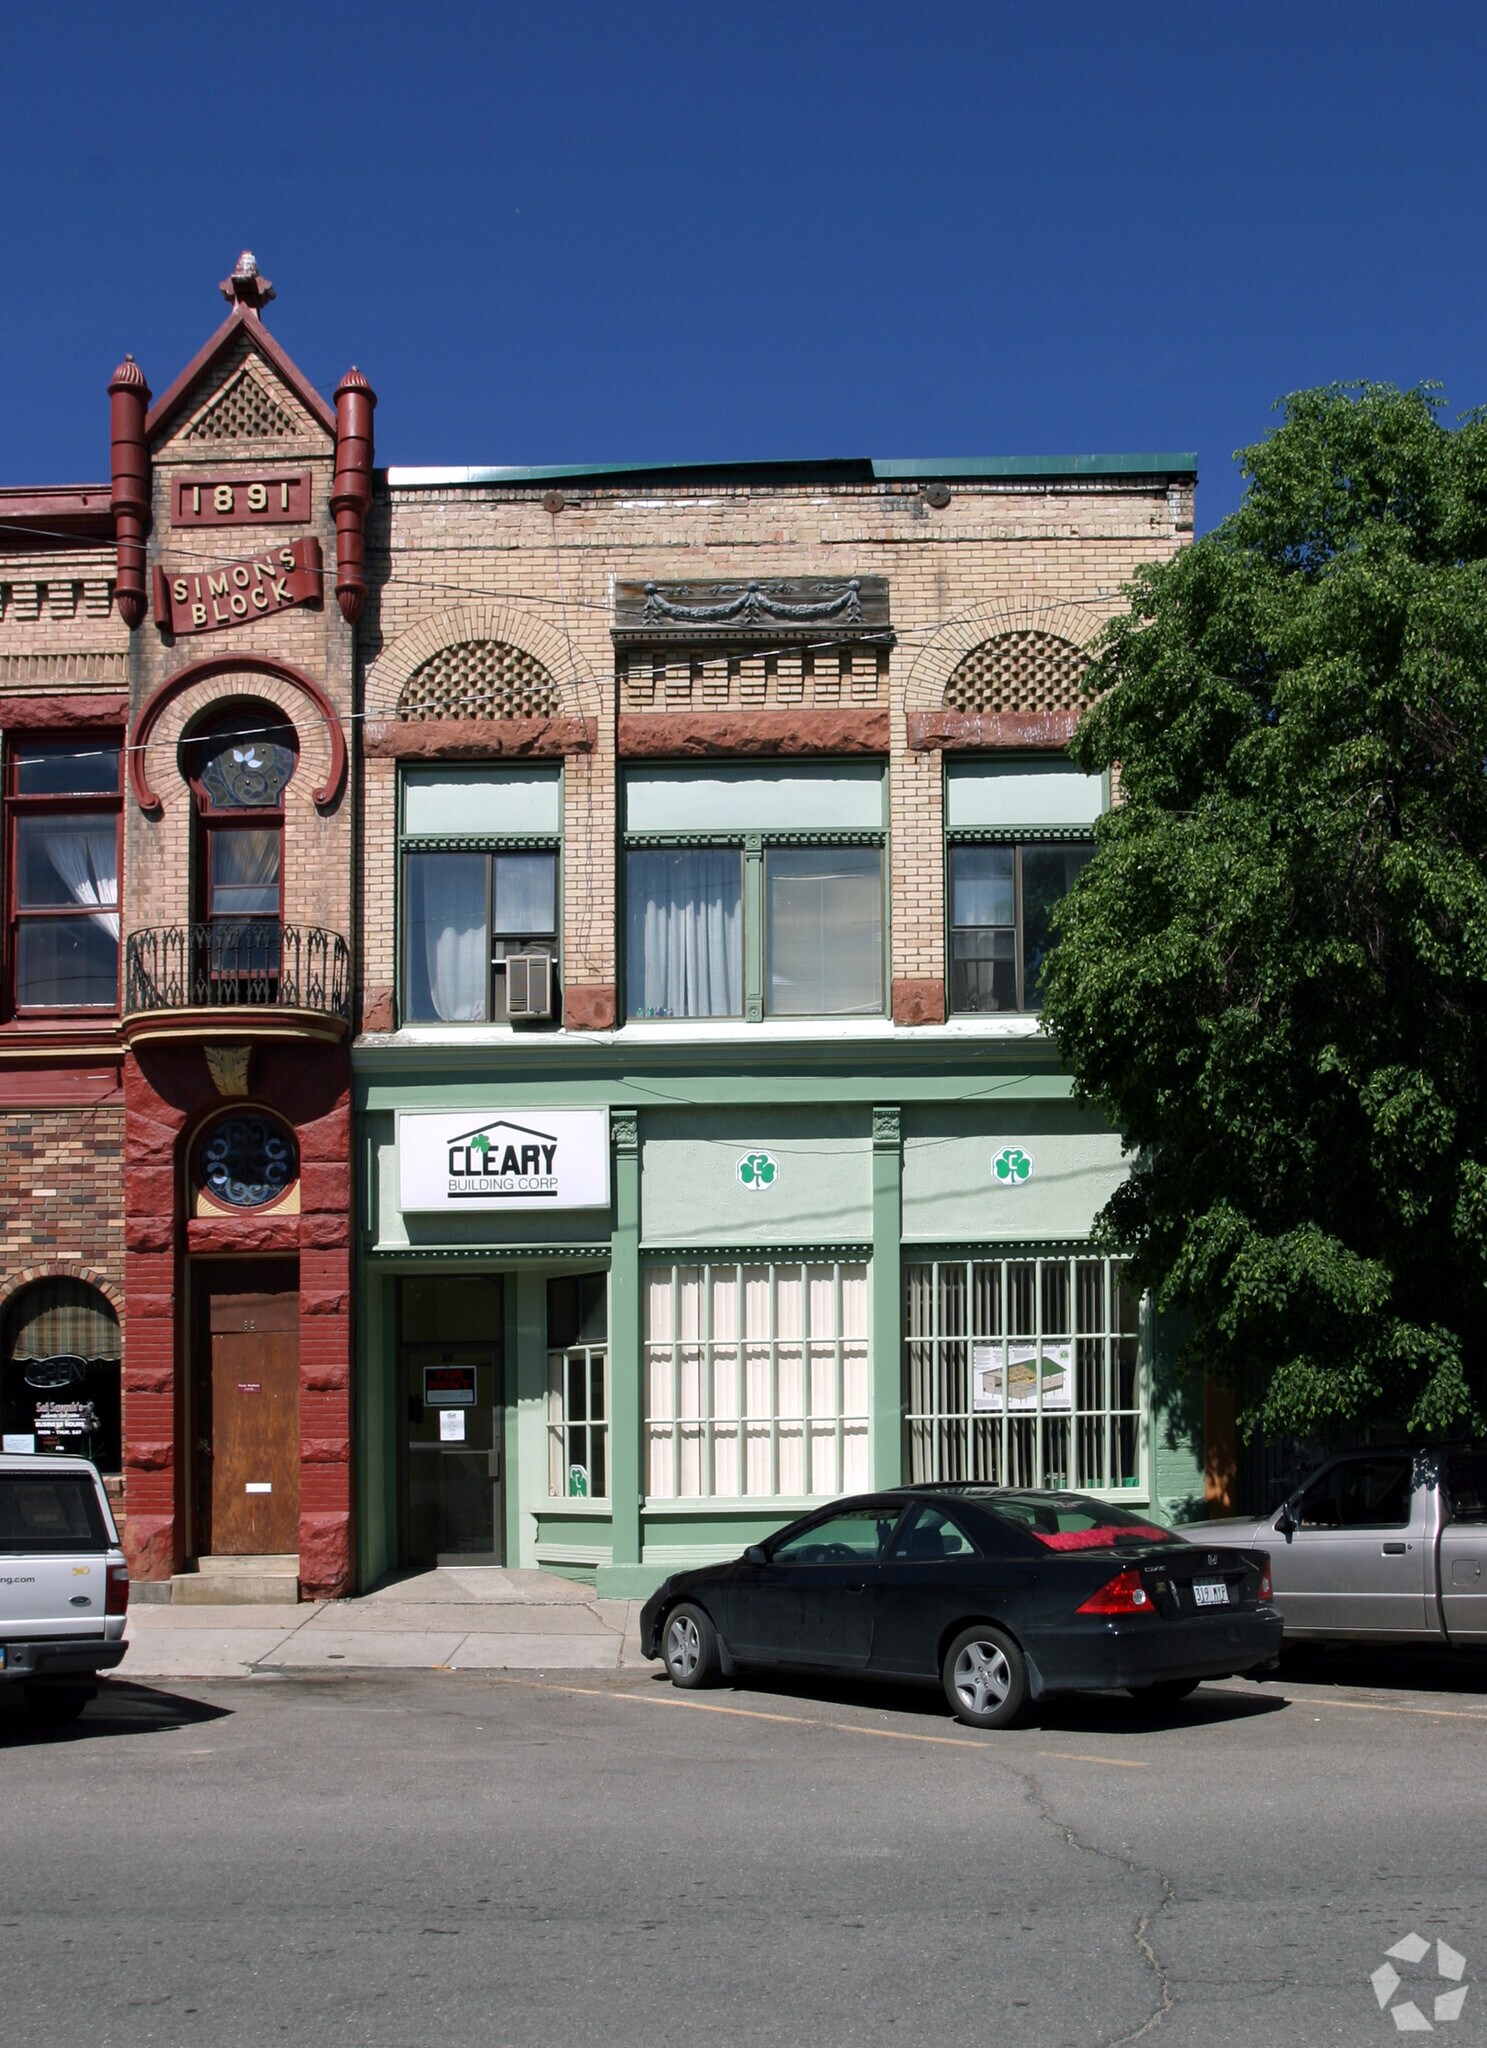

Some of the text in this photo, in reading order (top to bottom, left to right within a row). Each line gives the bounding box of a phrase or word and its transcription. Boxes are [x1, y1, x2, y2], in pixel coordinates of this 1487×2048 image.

[193, 483, 288, 511] 1891
[192, 577, 293, 625] BLOCK
[449, 1144, 557, 1176] CLEARY
[448, 1177, 559, 1191] BUILDING CORP.
[24, 1362, 86, 1382] OPEN
